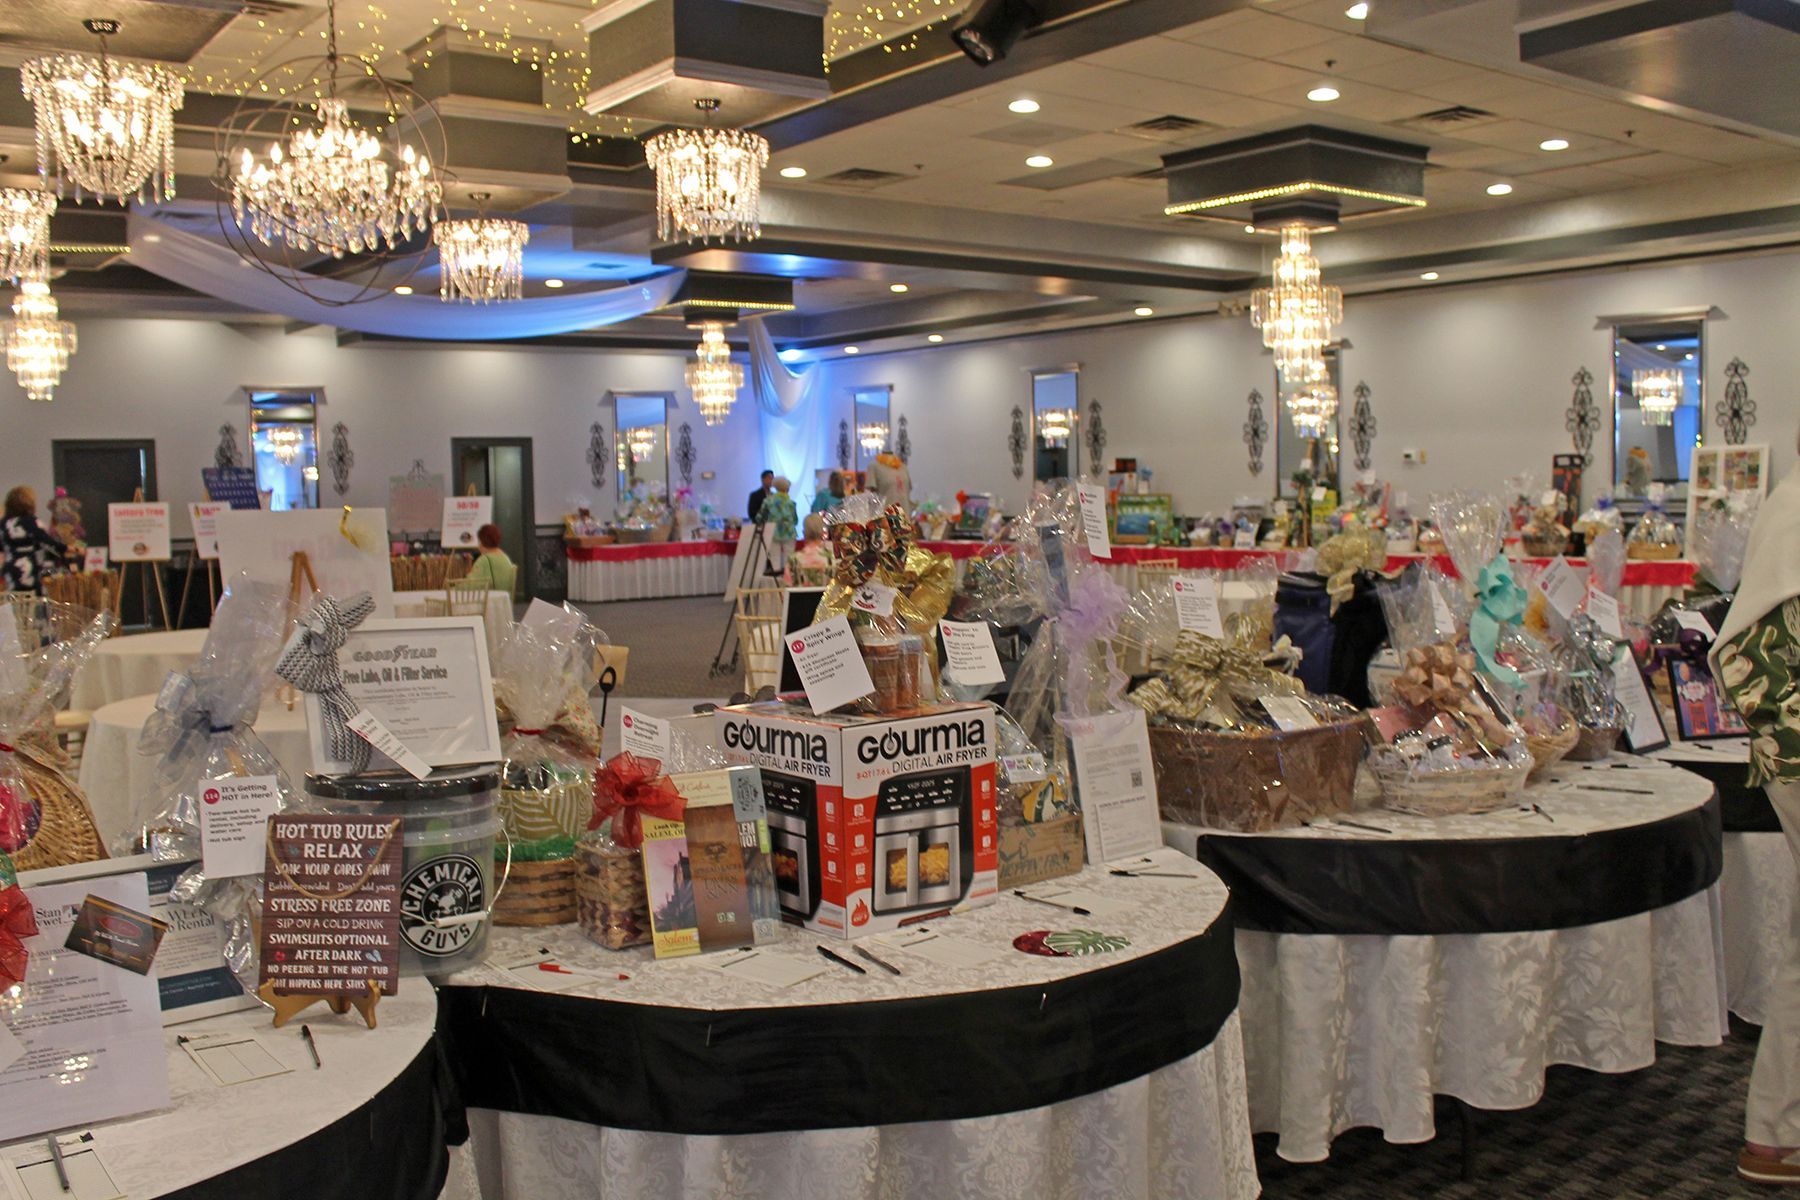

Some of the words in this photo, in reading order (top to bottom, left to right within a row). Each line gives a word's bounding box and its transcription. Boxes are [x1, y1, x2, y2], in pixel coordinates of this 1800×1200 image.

[804, 630, 824, 641] Crispy
[806, 639, 824, 648] Spicy
[825, 630, 845, 641] Wings
[343, 669, 360, 685] Free
[361, 668, 381, 686] Lube,
[382, 667, 393, 682] Oil
[394, 666, 400, 682] &
[401, 665, 419, 681] Filter
[421, 664, 448, 680] Service
[749, 752, 782, 770] DIGITAL
[784, 760, 799, 773] AIR
[802, 762, 831, 778] FRYER
[892, 757, 934, 774] DIGITAL
[936, 752, 953, 766] AIR
[956, 747, 987, 763] FRYER
[237, 784, 267, 792] Getting
[205, 793, 219, 801] 114
[276, 823, 308, 840] HOT
[311, 823, 342, 840] TUB
[345, 824, 393, 841] RULES
[738, 821, 756, 837] LEM
[303, 843, 363, 859] RELAX
[304, 863, 331, 876] YOUR
[334, 863, 363, 876] CARES
[401, 862, 481, 912] CHEMICAL
[270, 897, 319, 913] STRESS
[321, 898, 353, 914] FREE
[355, 898, 392, 913] ZONE
[36, 907, 62, 920] Stan
[178, 915, 215, 930] Rental
[276, 918, 295, 929] SIP
[296, 918, 311, 929] ON
[312, 918, 320, 929] A
[322, 919, 350, 929] COLD
[351, 919, 384, 930] DRINK
[269, 933, 333, 945] SWIMSUITS
[334, 934, 390, 946] OPTIONAL
[420, 922, 471, 949] GUYS
[294, 949, 330, 961] AFTER
[331, 949, 362, 961] DARK
[267, 964, 279, 974] NO
[281, 964, 315, 974] PEEING
[317, 965, 329, 974] IN
[332, 965, 348, 974] THE
[351, 965, 369, 975] HOT
[372, 965, 389, 975] TUB
[288, 978, 322, 989] HAPPENS
[324, 979, 343, 989] HERE
[346, 979, 366, 989] STAYS
